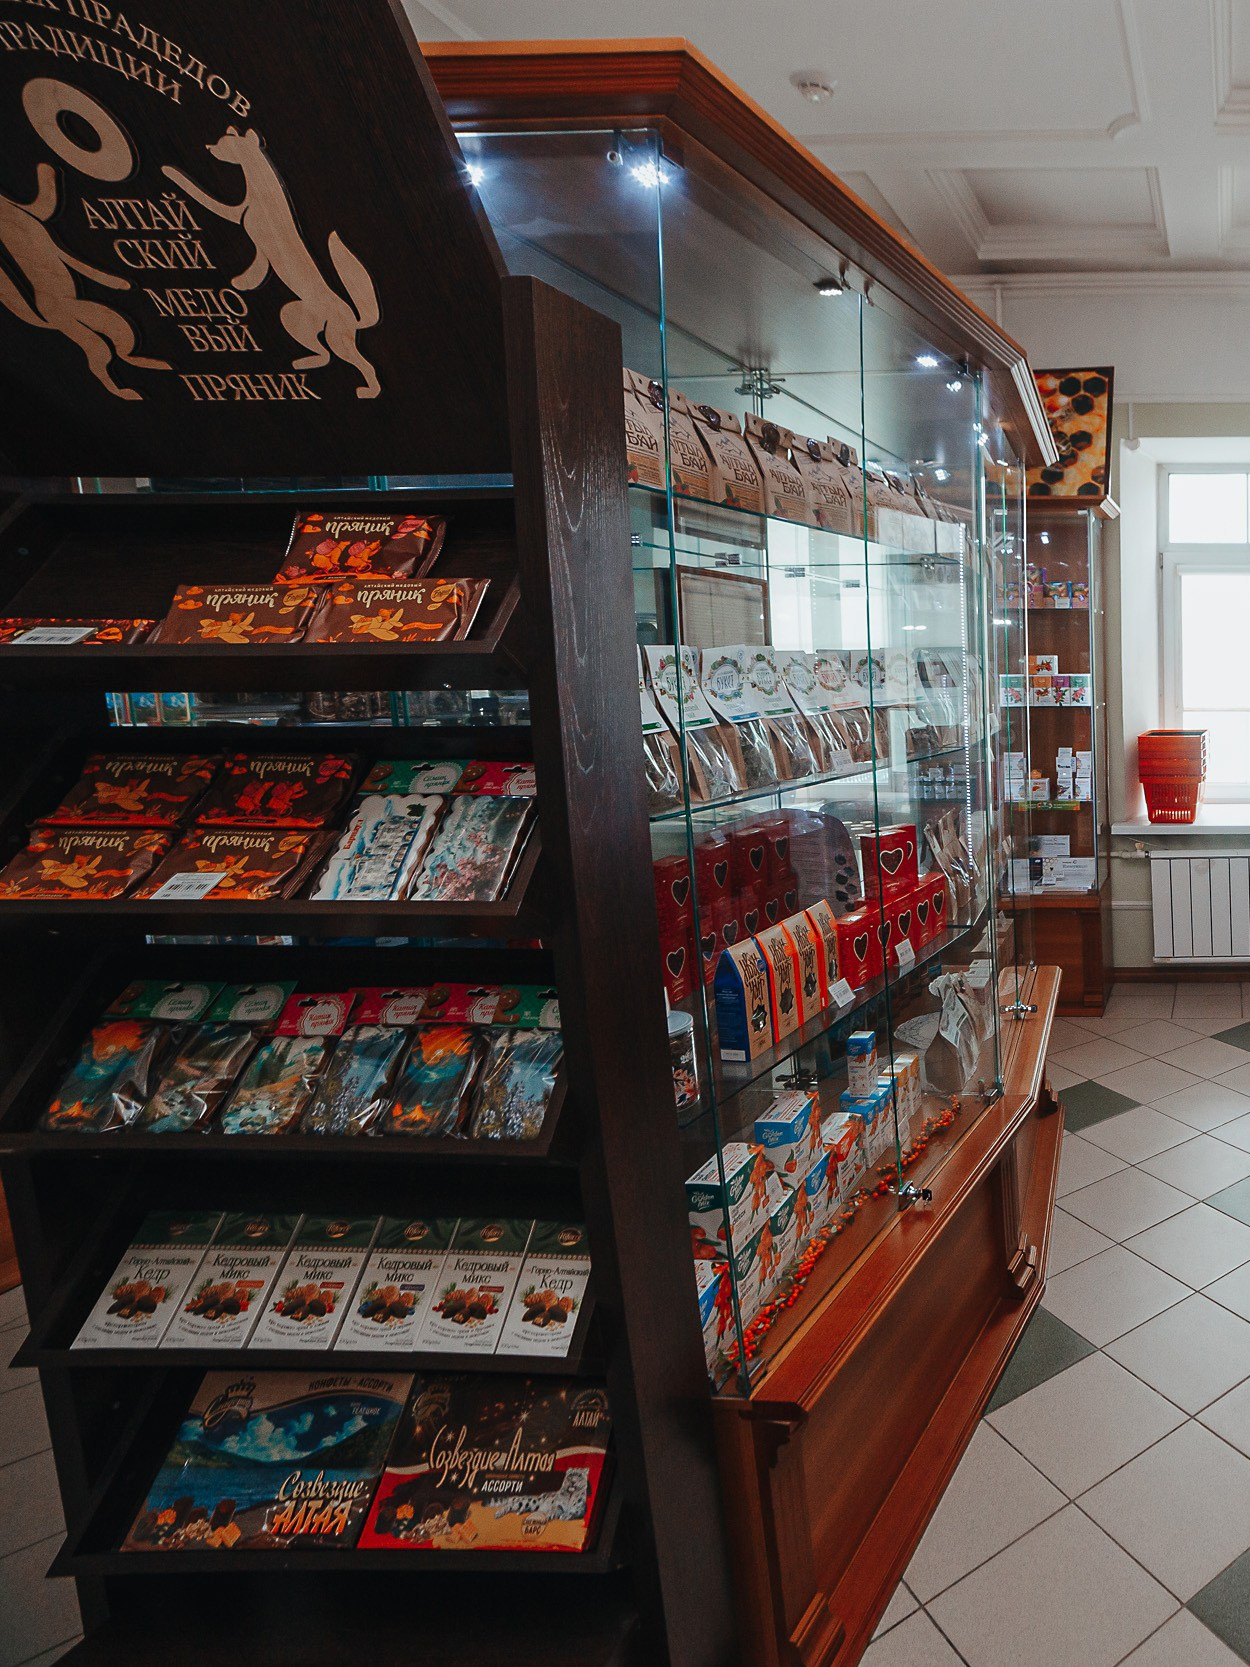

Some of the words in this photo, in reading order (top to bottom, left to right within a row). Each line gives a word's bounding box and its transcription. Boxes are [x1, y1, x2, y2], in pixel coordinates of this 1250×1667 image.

[66, 0, 251, 117] ПРАДЕДОВ
[81, 192, 201, 230] АЛТАЙ
[112, 234, 216, 269] СКИЙ
[143, 287, 248, 322] МЕДО
[178, 318, 262, 353] ВЫЙ
[179, 373, 321, 400] ПРЯНИК
[626, 431, 659, 452] БАЙ
[325, 520, 394, 538] пряник
[206, 592, 278, 612] пряник
[357, 587, 426, 608] пряник
[250, 758, 315, 779] пряник
[58, 834, 130, 854] пряник
[202, 834, 275, 857] пряник
[213, 1253, 271, 1268] Кедровый
[296, 1253, 353, 1270] Кедровый
[376, 1256, 433, 1270] Кедровый
[453, 1258, 510, 1273] Кедровый
[134, 1265, 171, 1283] Кедр
[539, 1275, 574, 1293] Кедр
[358, 1377, 393, 1392] АССОРТИ
[572, 1409, 600, 1428] АЛТАЙ
[429, 1424, 502, 1489] Созвездие
[503, 1426, 557, 1472] Алтая
[279, 1470, 365, 1502] Созвездие
[481, 1480, 523, 1493] АССОРТИ
[271, 1500, 353, 1535] АЛТАЯ
